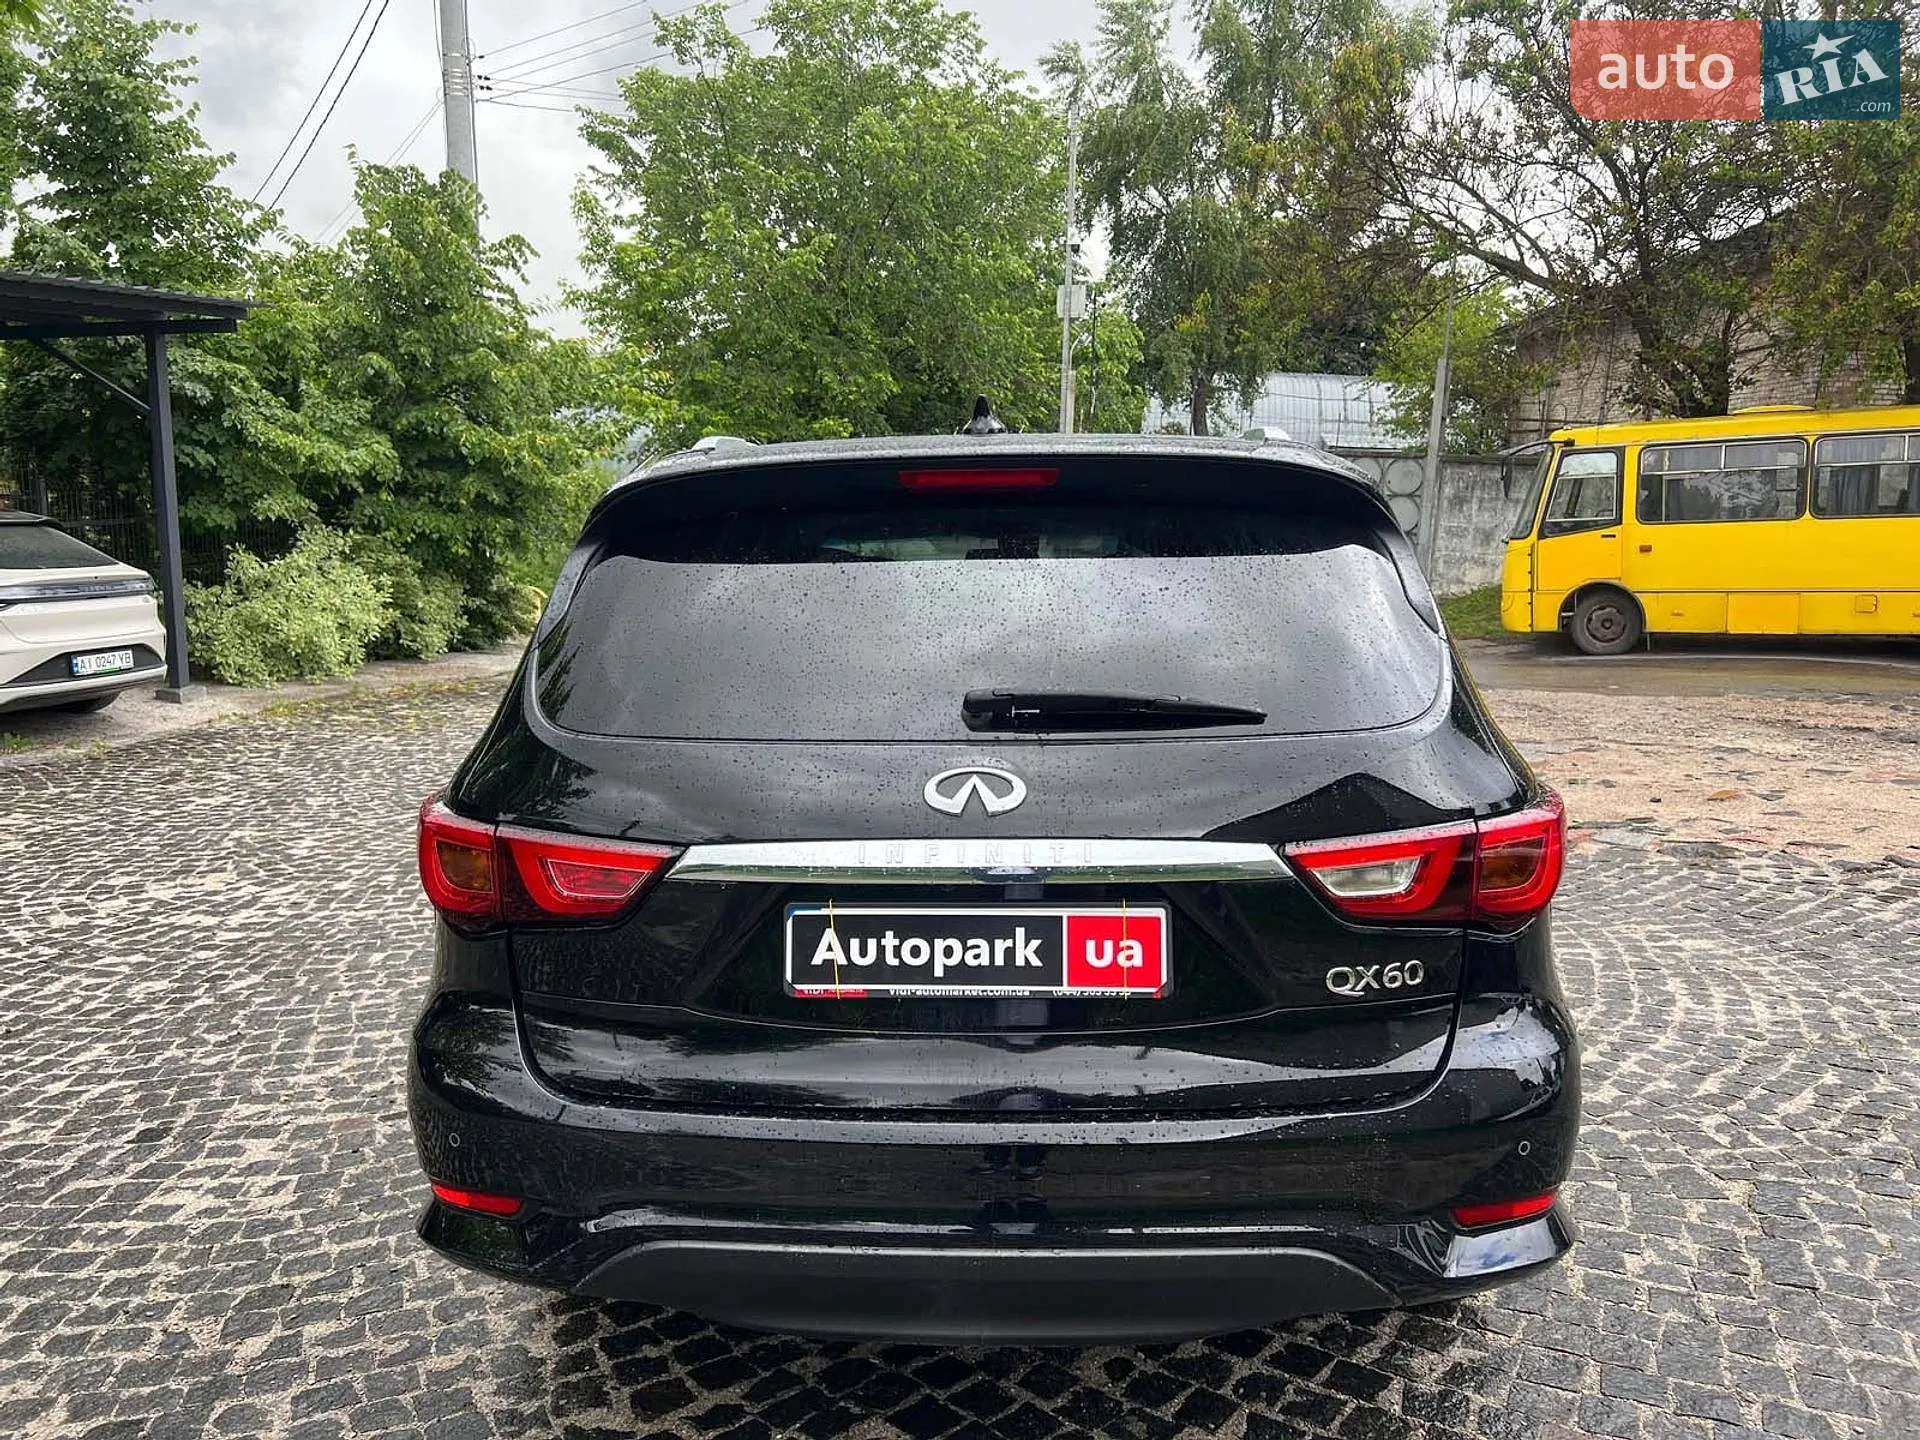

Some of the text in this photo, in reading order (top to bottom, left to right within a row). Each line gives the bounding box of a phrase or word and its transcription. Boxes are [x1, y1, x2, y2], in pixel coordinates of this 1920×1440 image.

[79, 652, 131, 670] AI 0247 YB
[858, 843, 1092, 864] INFINITI
[810, 926, 1144, 978] Autopark ua
[1325, 959, 1425, 997] QX60
